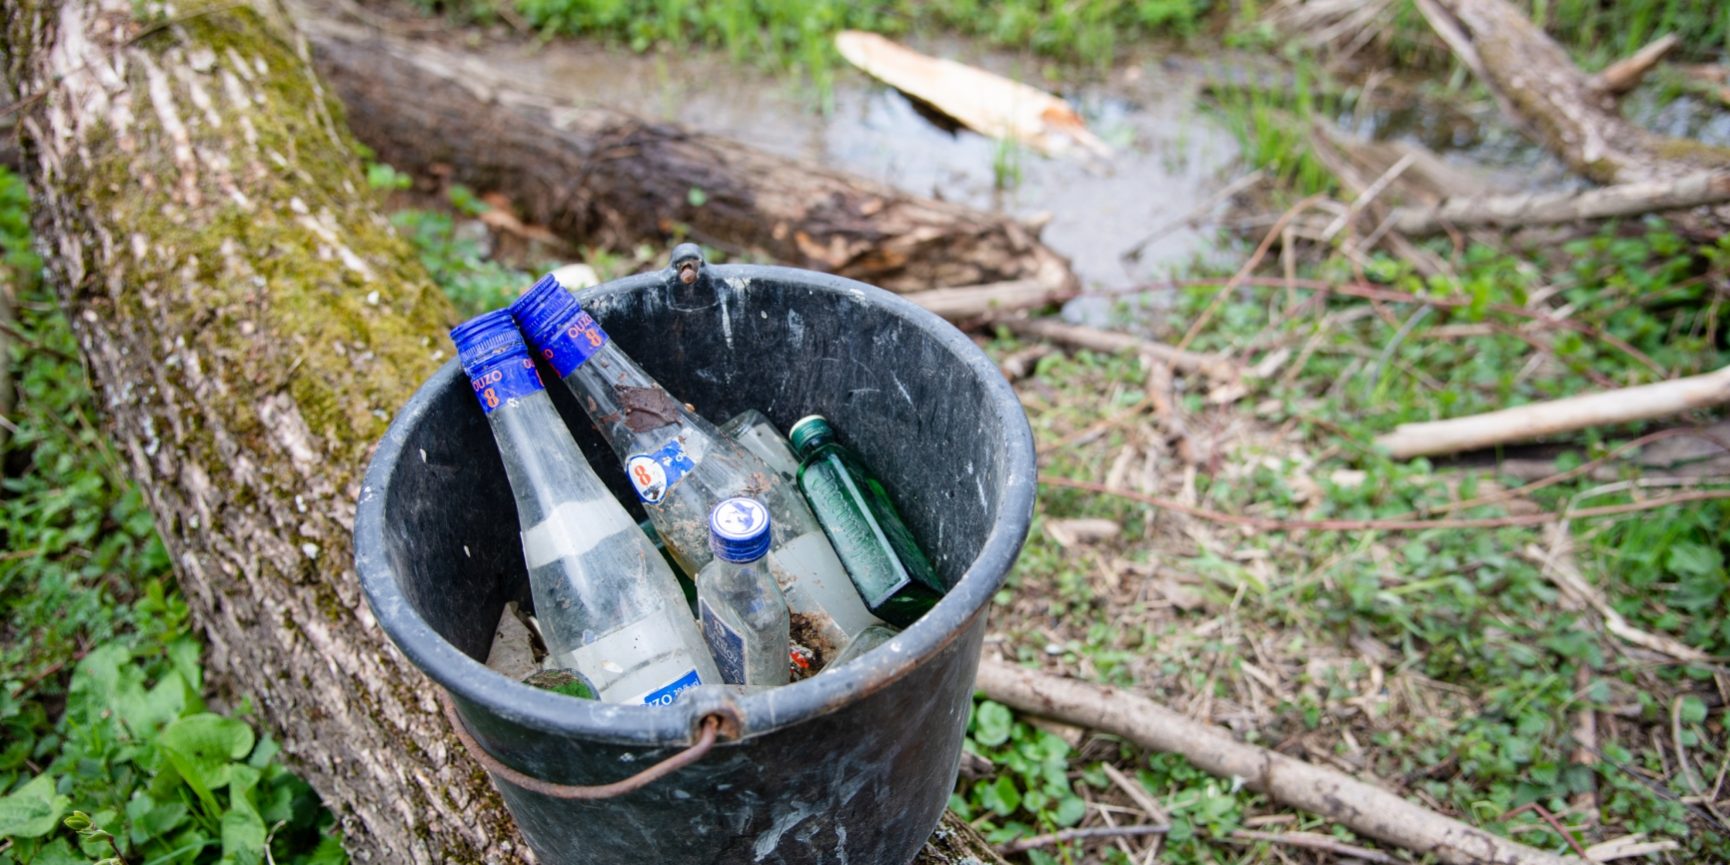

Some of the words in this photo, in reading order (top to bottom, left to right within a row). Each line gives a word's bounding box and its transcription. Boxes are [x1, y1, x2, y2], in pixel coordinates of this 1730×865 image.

[568, 313, 592, 338] OUZO
[586, 328, 601, 346] 8
[472, 370, 503, 391] OUZO
[483, 387, 500, 408] 8
[634, 465, 652, 486] 8
